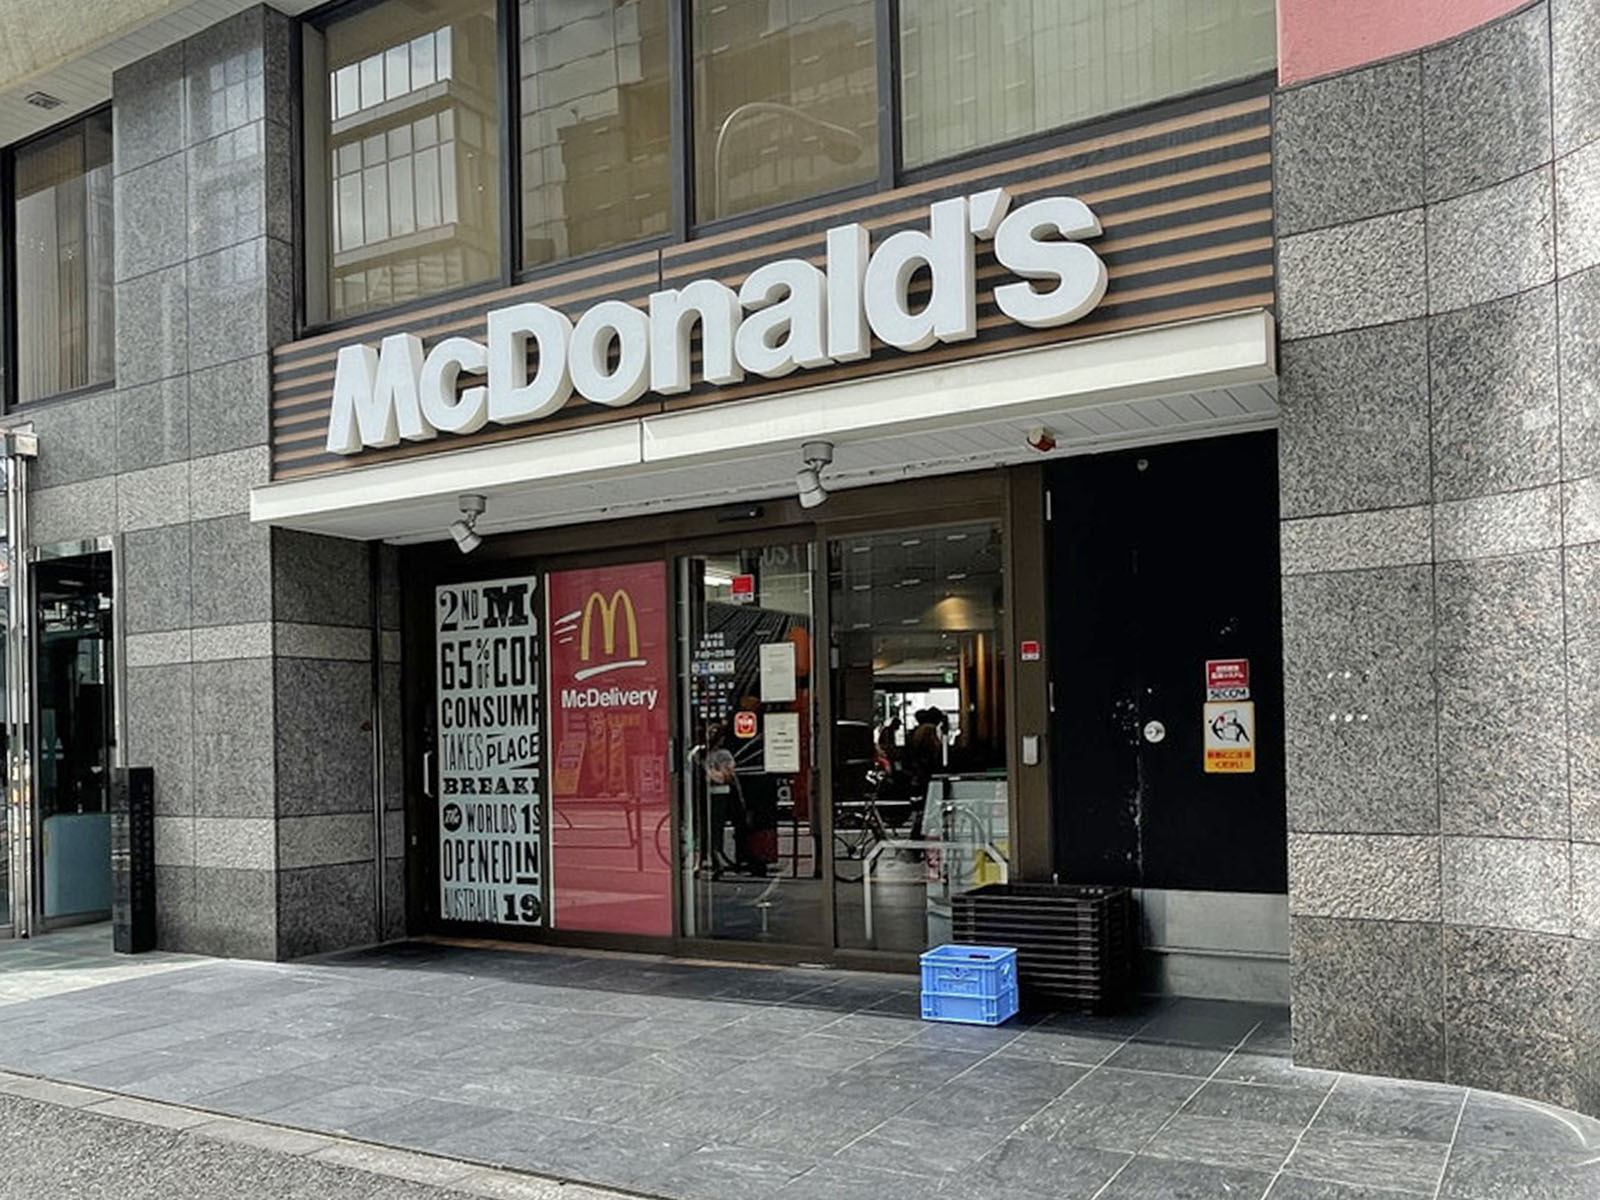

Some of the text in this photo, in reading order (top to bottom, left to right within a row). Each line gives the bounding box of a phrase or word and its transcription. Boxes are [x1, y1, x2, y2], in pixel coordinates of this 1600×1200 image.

[326, 187, 1108, 454] McDonald's
[561, 687, 658, 710] McDelivery
[442, 732, 484, 771] TAKES
[486, 732, 539, 767] PLACE
[465, 803, 517, 834] WORLDS
[443, 839, 538, 884] OPENED IN
[444, 887, 498, 922] AUSTRALIA
